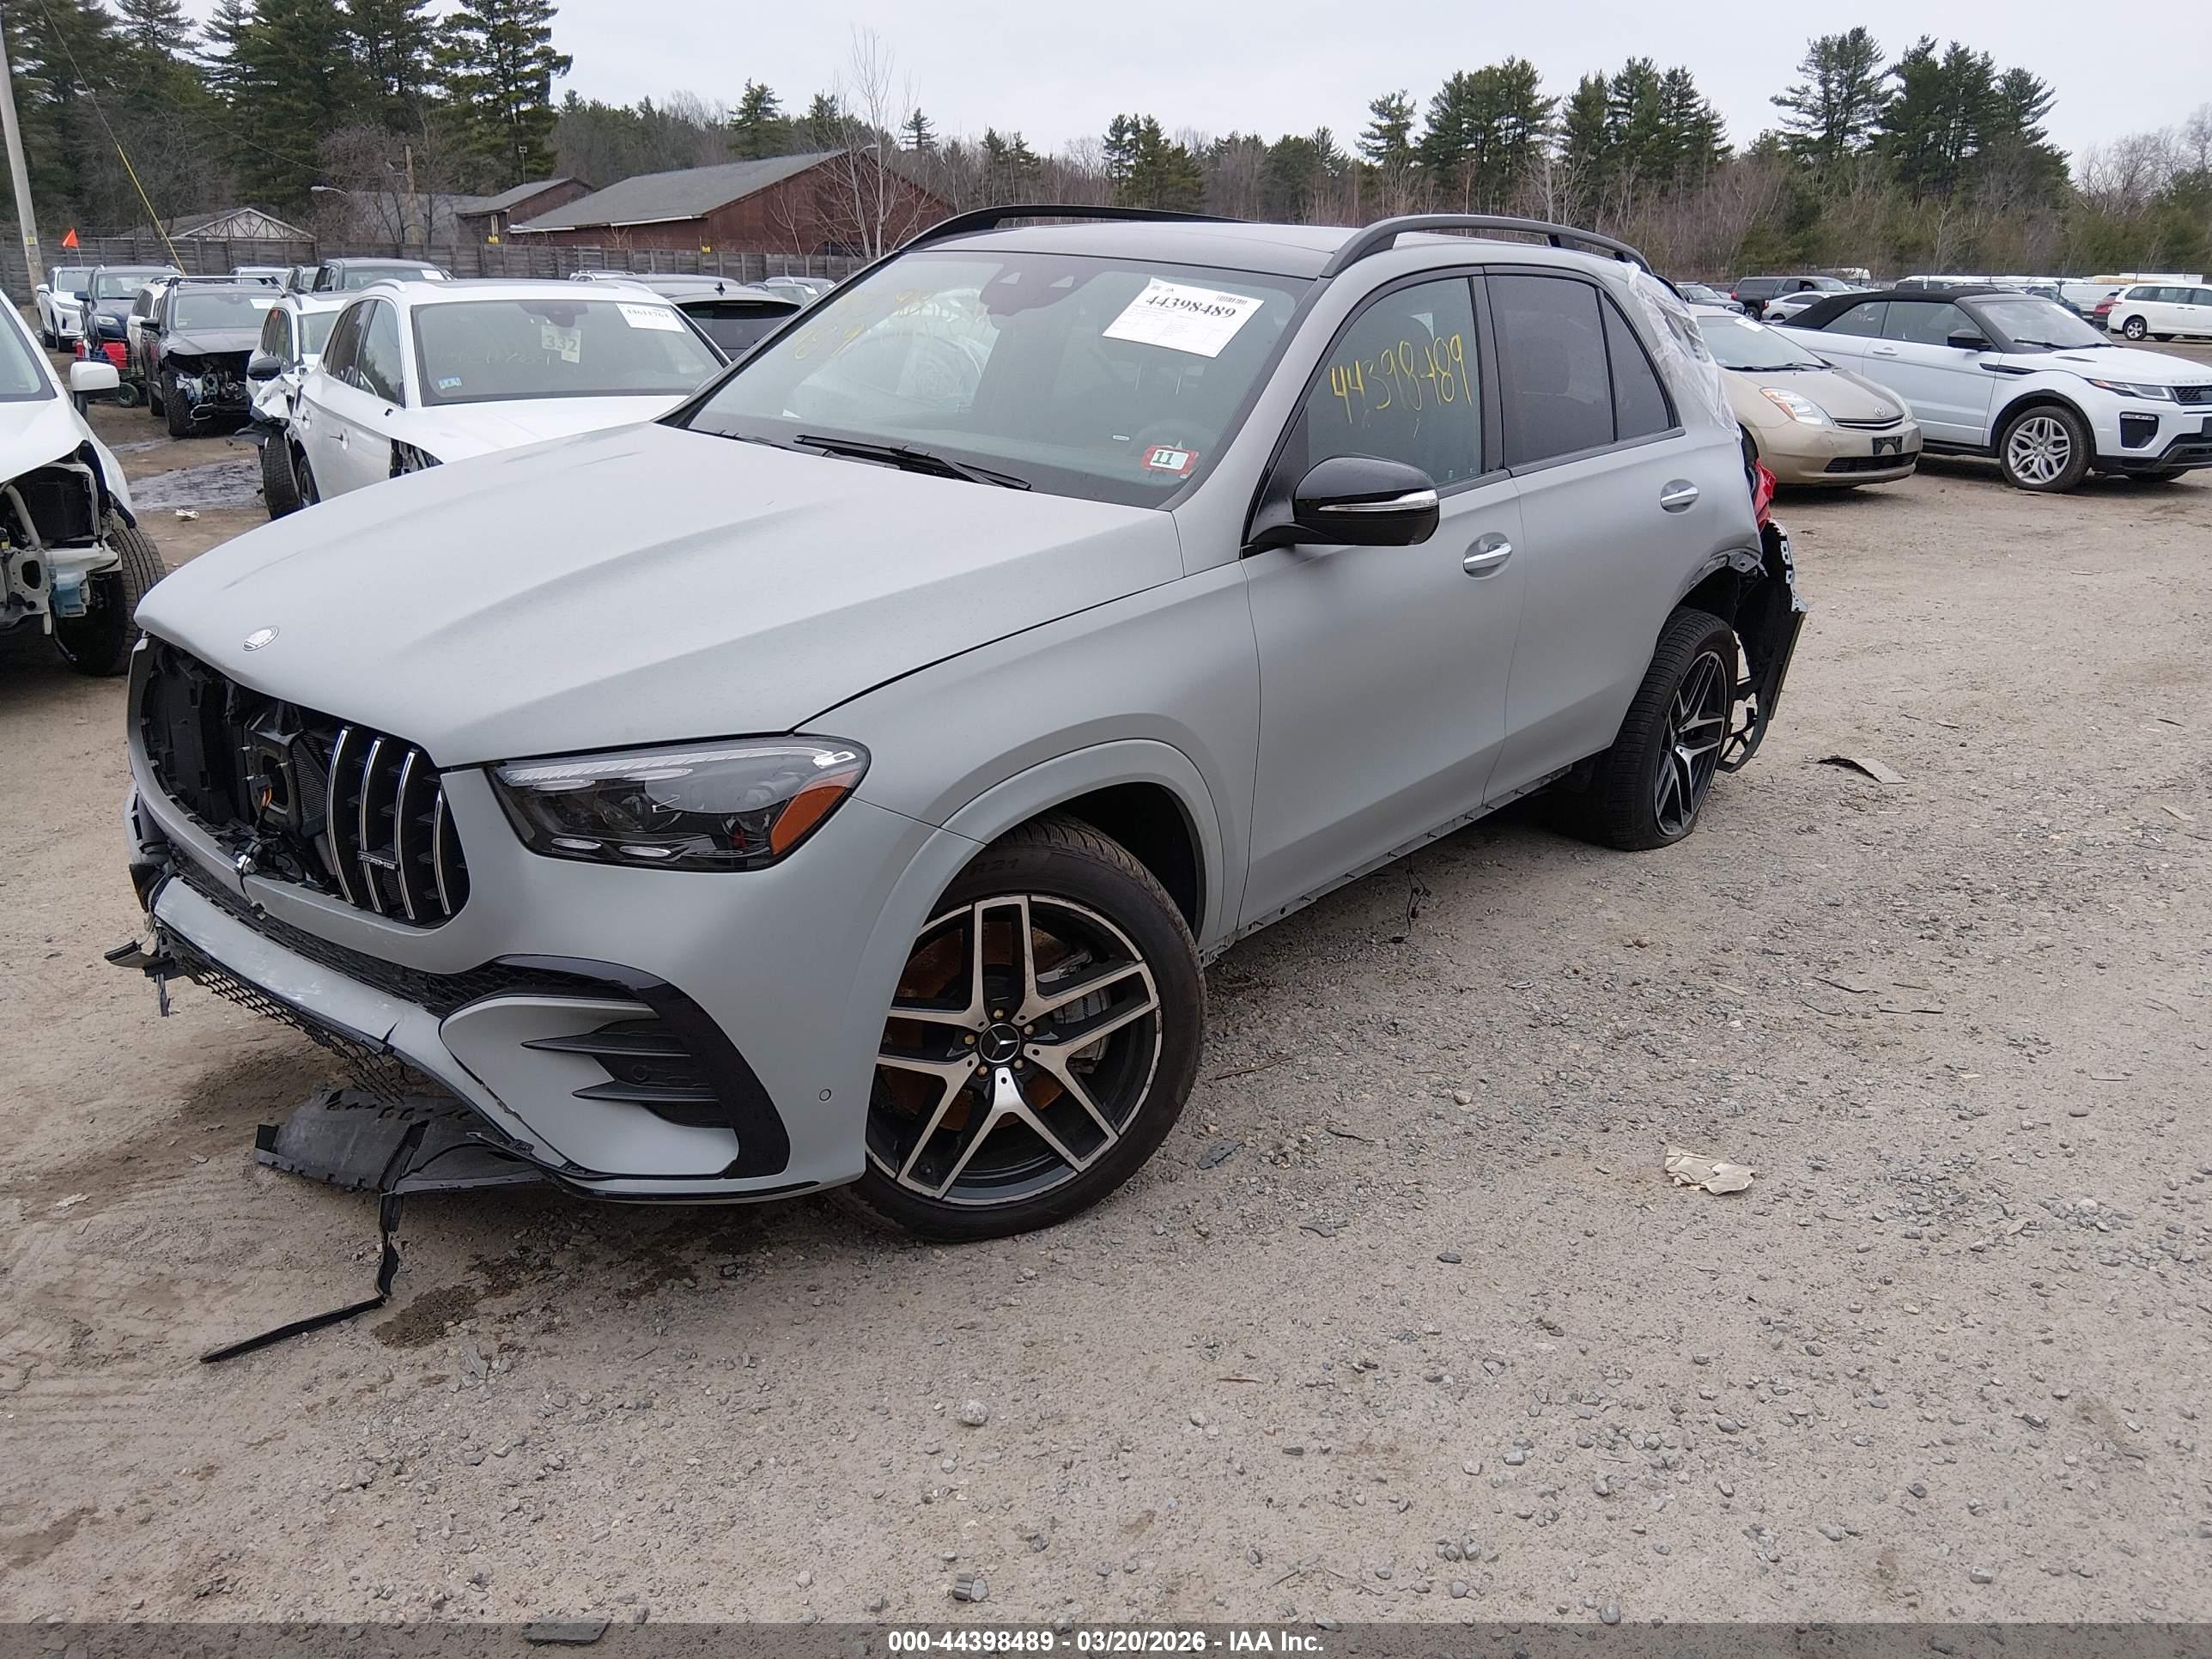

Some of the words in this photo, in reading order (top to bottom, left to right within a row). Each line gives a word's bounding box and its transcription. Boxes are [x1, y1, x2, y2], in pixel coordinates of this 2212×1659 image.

[1146, 295, 1237, 319] 44398489
[545, 335, 578, 353] 332
[1332, 332, 1473, 423] 44398489
[1152, 451, 1174, 465] 11
[971, 858, 1019, 874] R21
